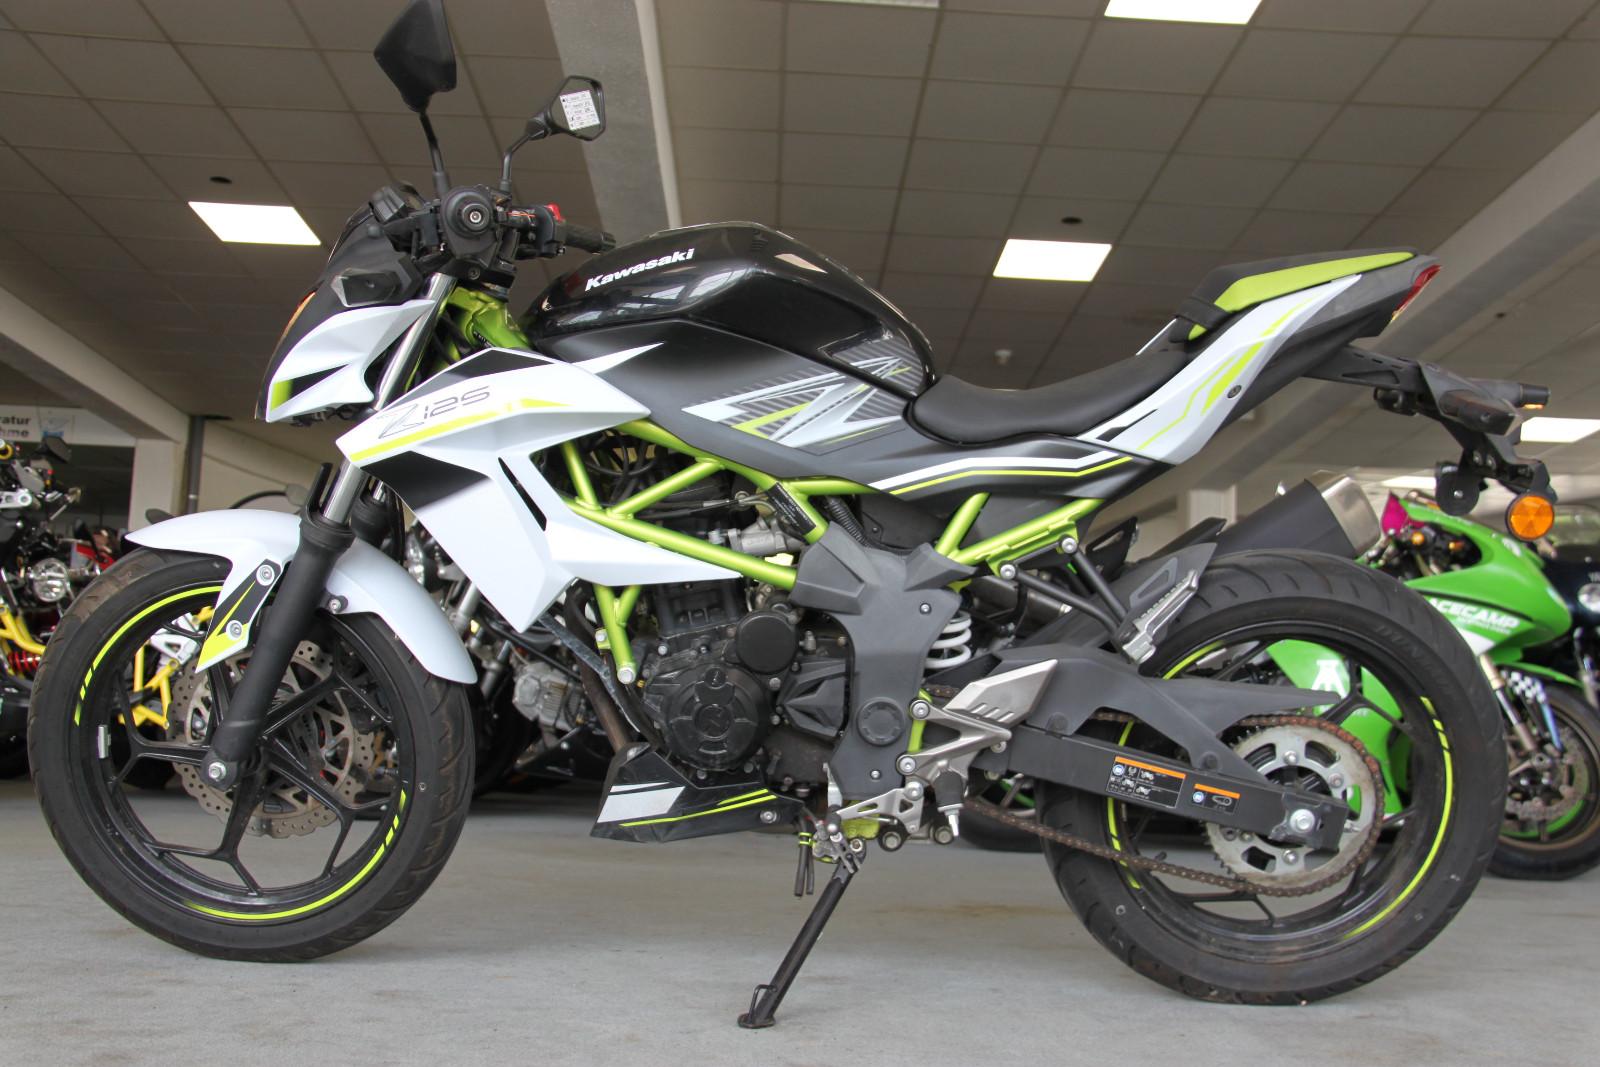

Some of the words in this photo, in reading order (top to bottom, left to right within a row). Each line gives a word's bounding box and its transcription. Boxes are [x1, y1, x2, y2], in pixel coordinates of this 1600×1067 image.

[585, 248, 695, 292] Kawasaki
[0, 415, 31, 426] atur
[377, 386, 490, 439] Z125
